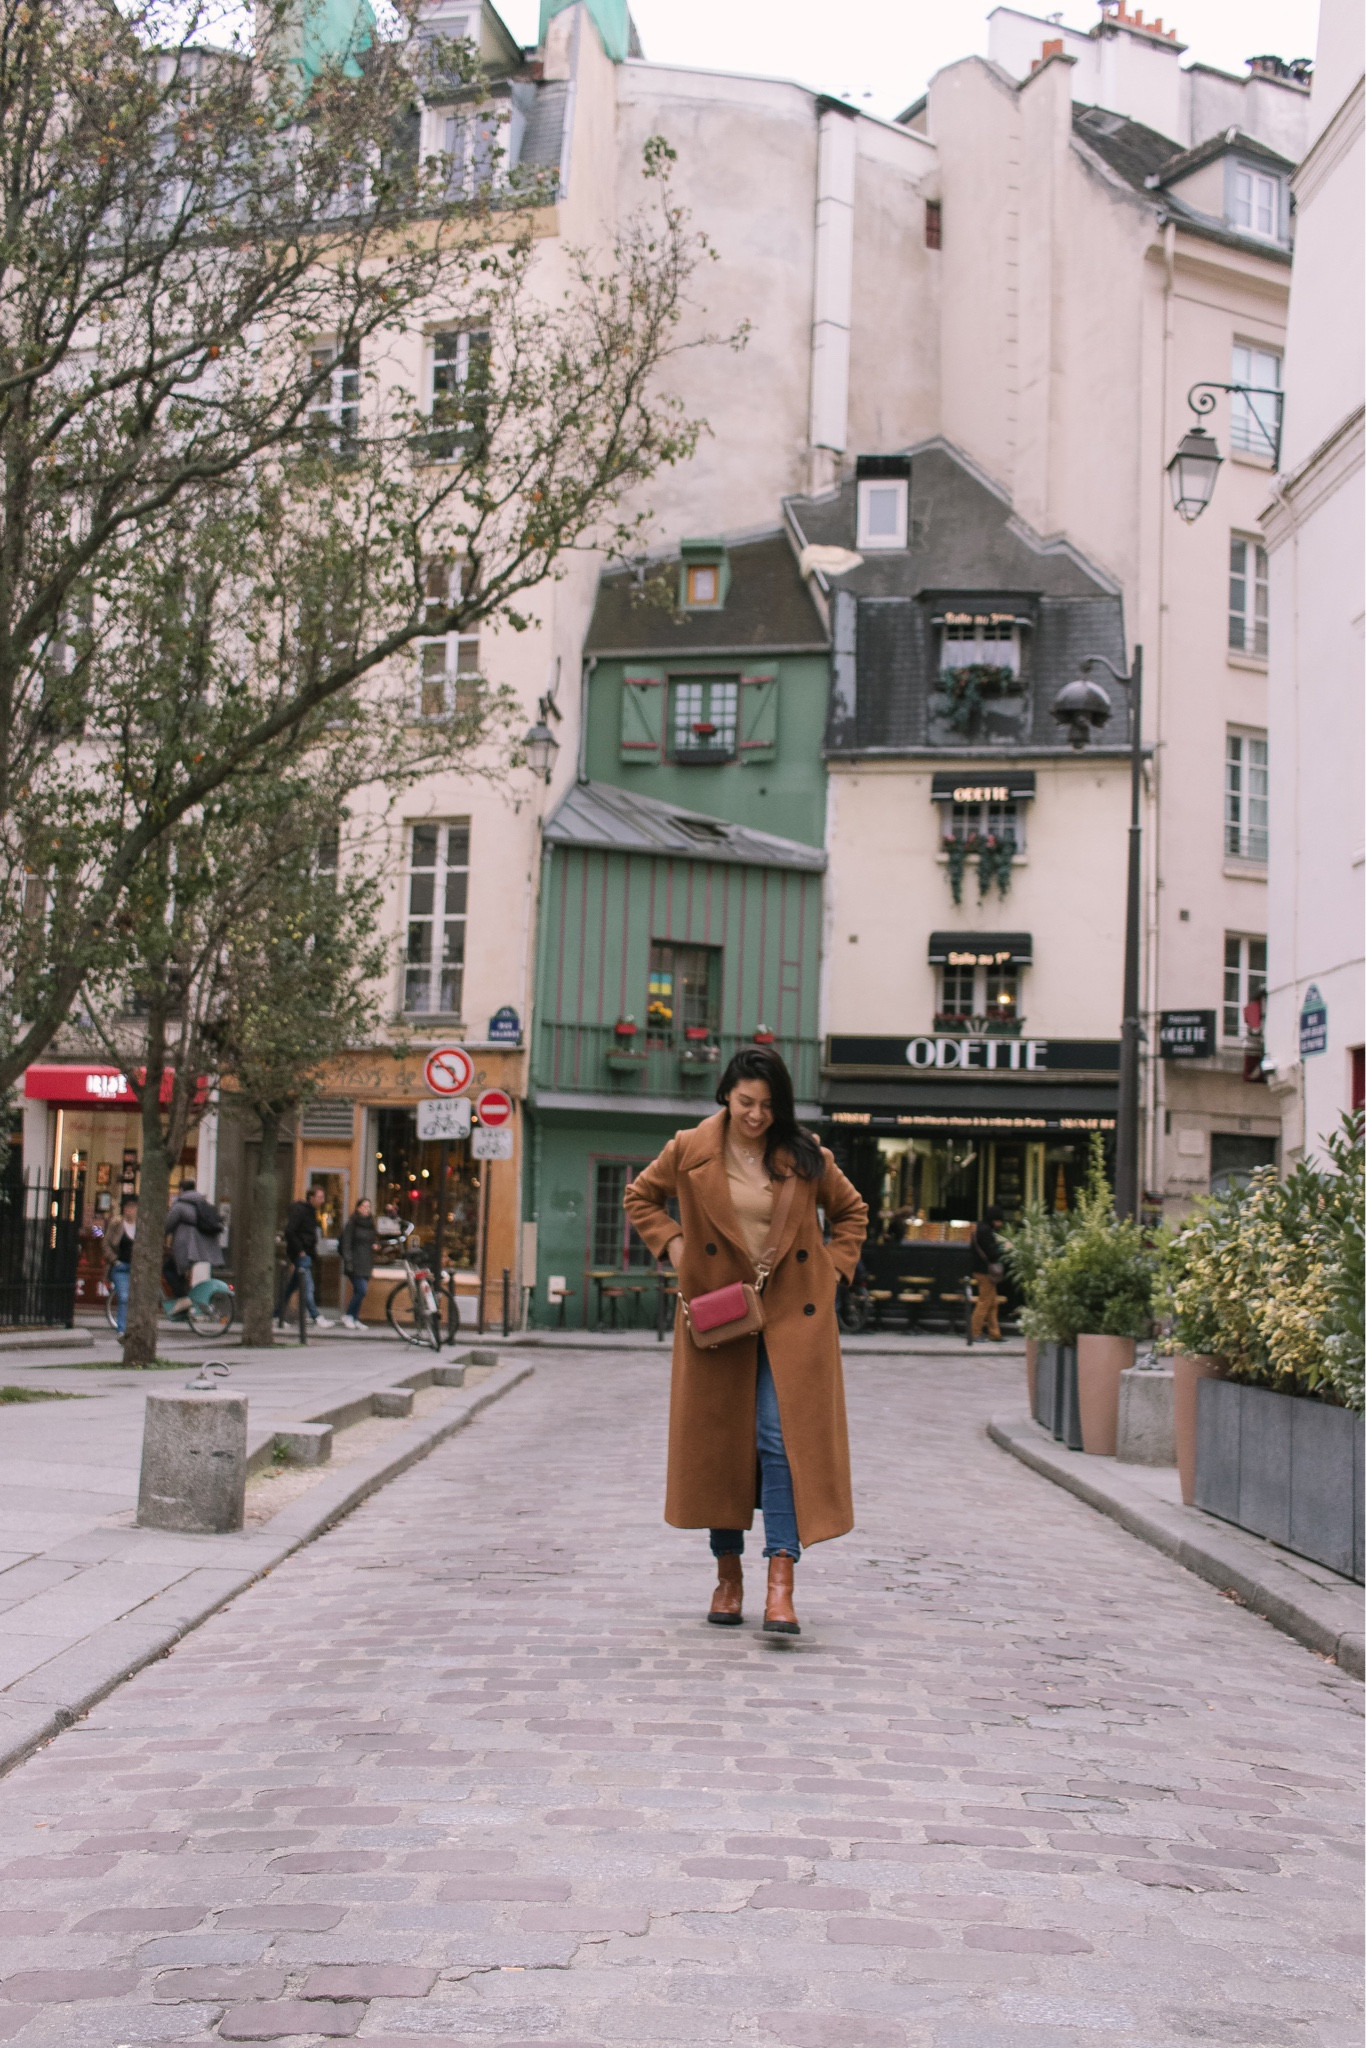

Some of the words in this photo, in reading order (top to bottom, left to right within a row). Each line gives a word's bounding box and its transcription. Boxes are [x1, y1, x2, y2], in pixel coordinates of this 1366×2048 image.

[977, 953, 994, 965] au
[905, 1037, 1048, 1071] ODETTE
[428, 1101, 460, 1113] SAUF
